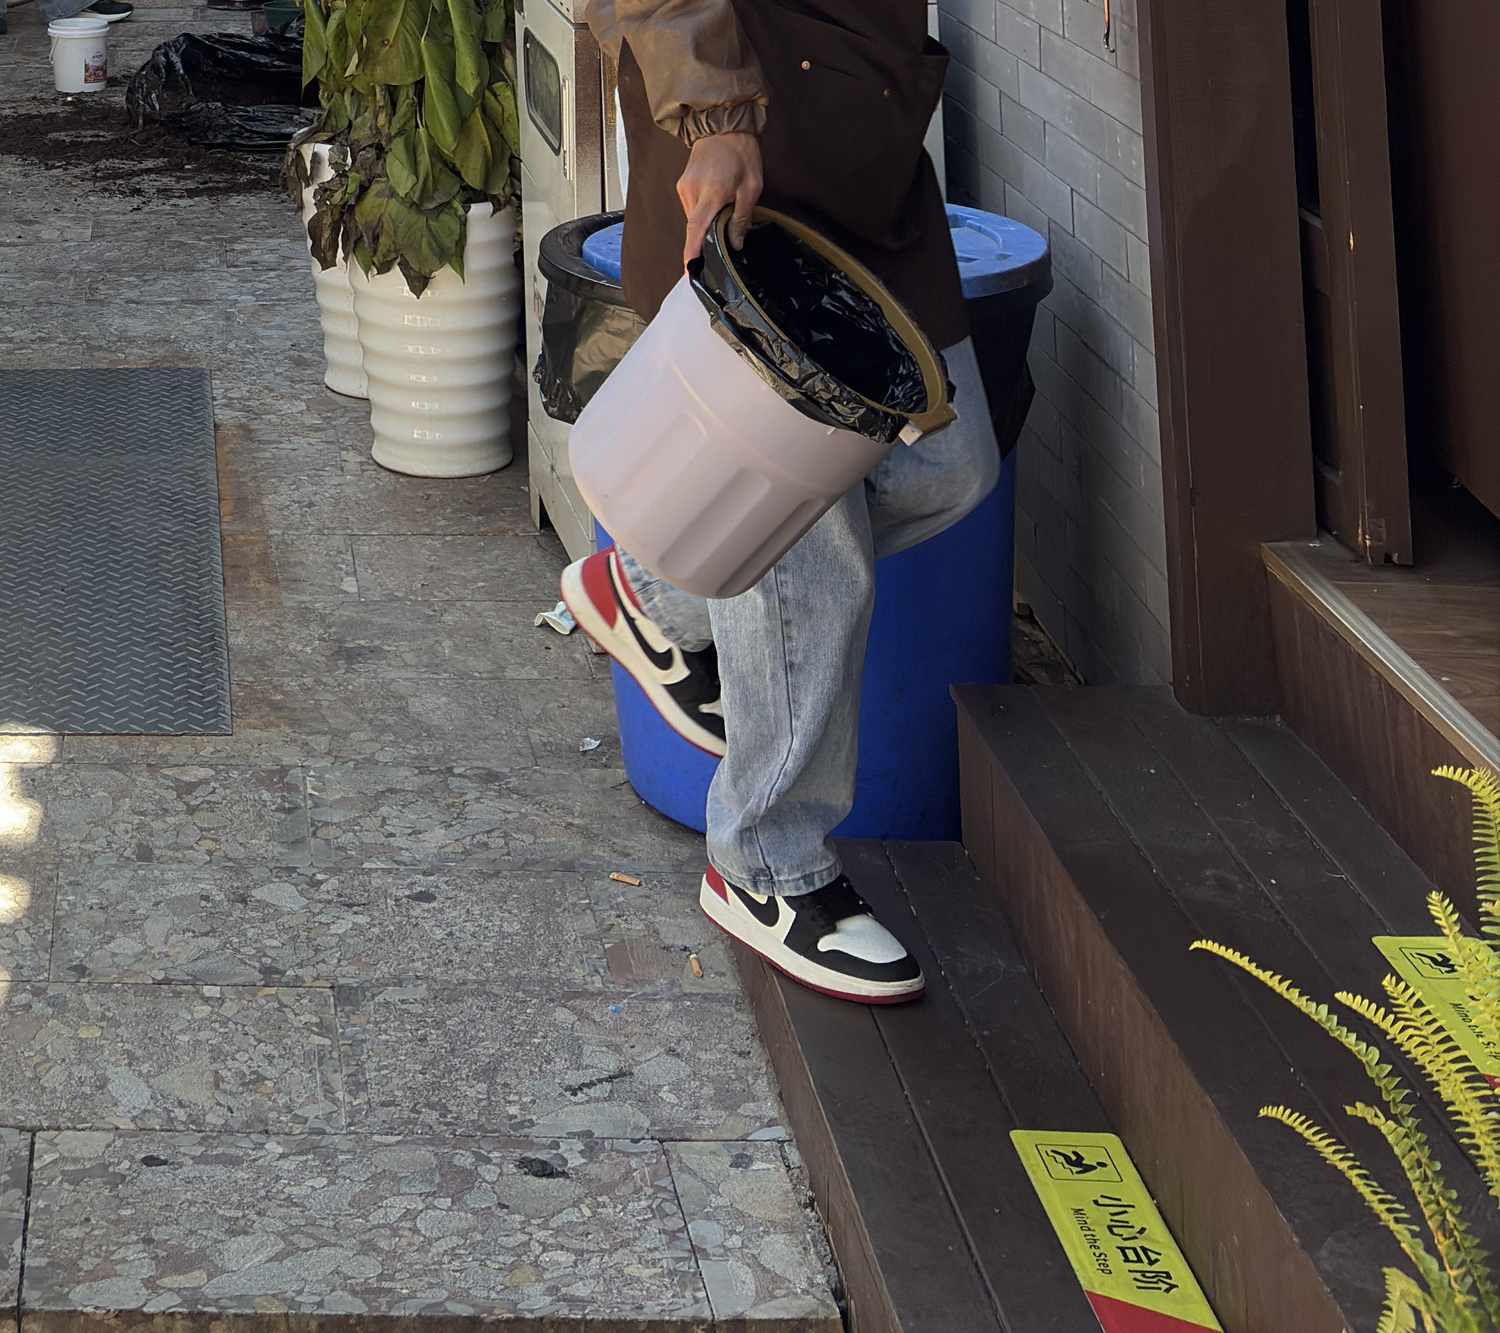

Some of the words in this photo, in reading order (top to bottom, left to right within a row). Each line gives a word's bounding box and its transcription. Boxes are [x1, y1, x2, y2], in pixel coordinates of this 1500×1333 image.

[1071, 1208, 1096, 1232] Mind
[1084, 1233, 1100, 1250] the
[1093, 1252, 1112, 1275] Step
[1092, 1194, 1179, 1293] 小心台阶
